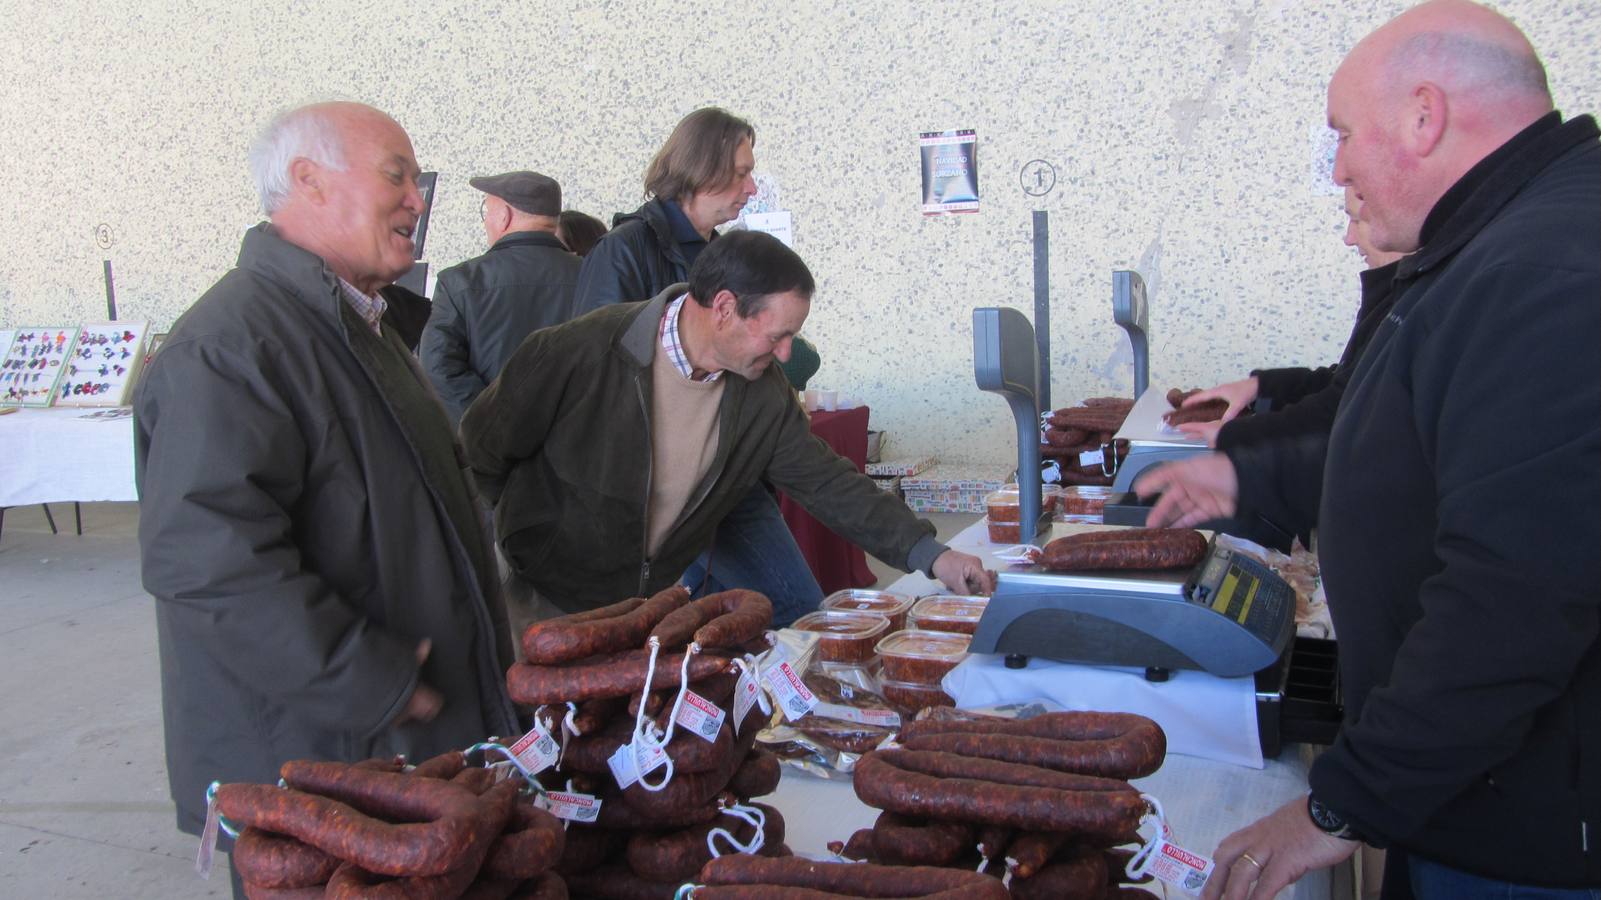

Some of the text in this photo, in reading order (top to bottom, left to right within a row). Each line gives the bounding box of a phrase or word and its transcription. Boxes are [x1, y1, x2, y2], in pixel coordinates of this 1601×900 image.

[1033, 168, 1044, 187] 1
[100, 229, 109, 243] 3
[1166, 846, 1205, 870] MONCALVILLO
